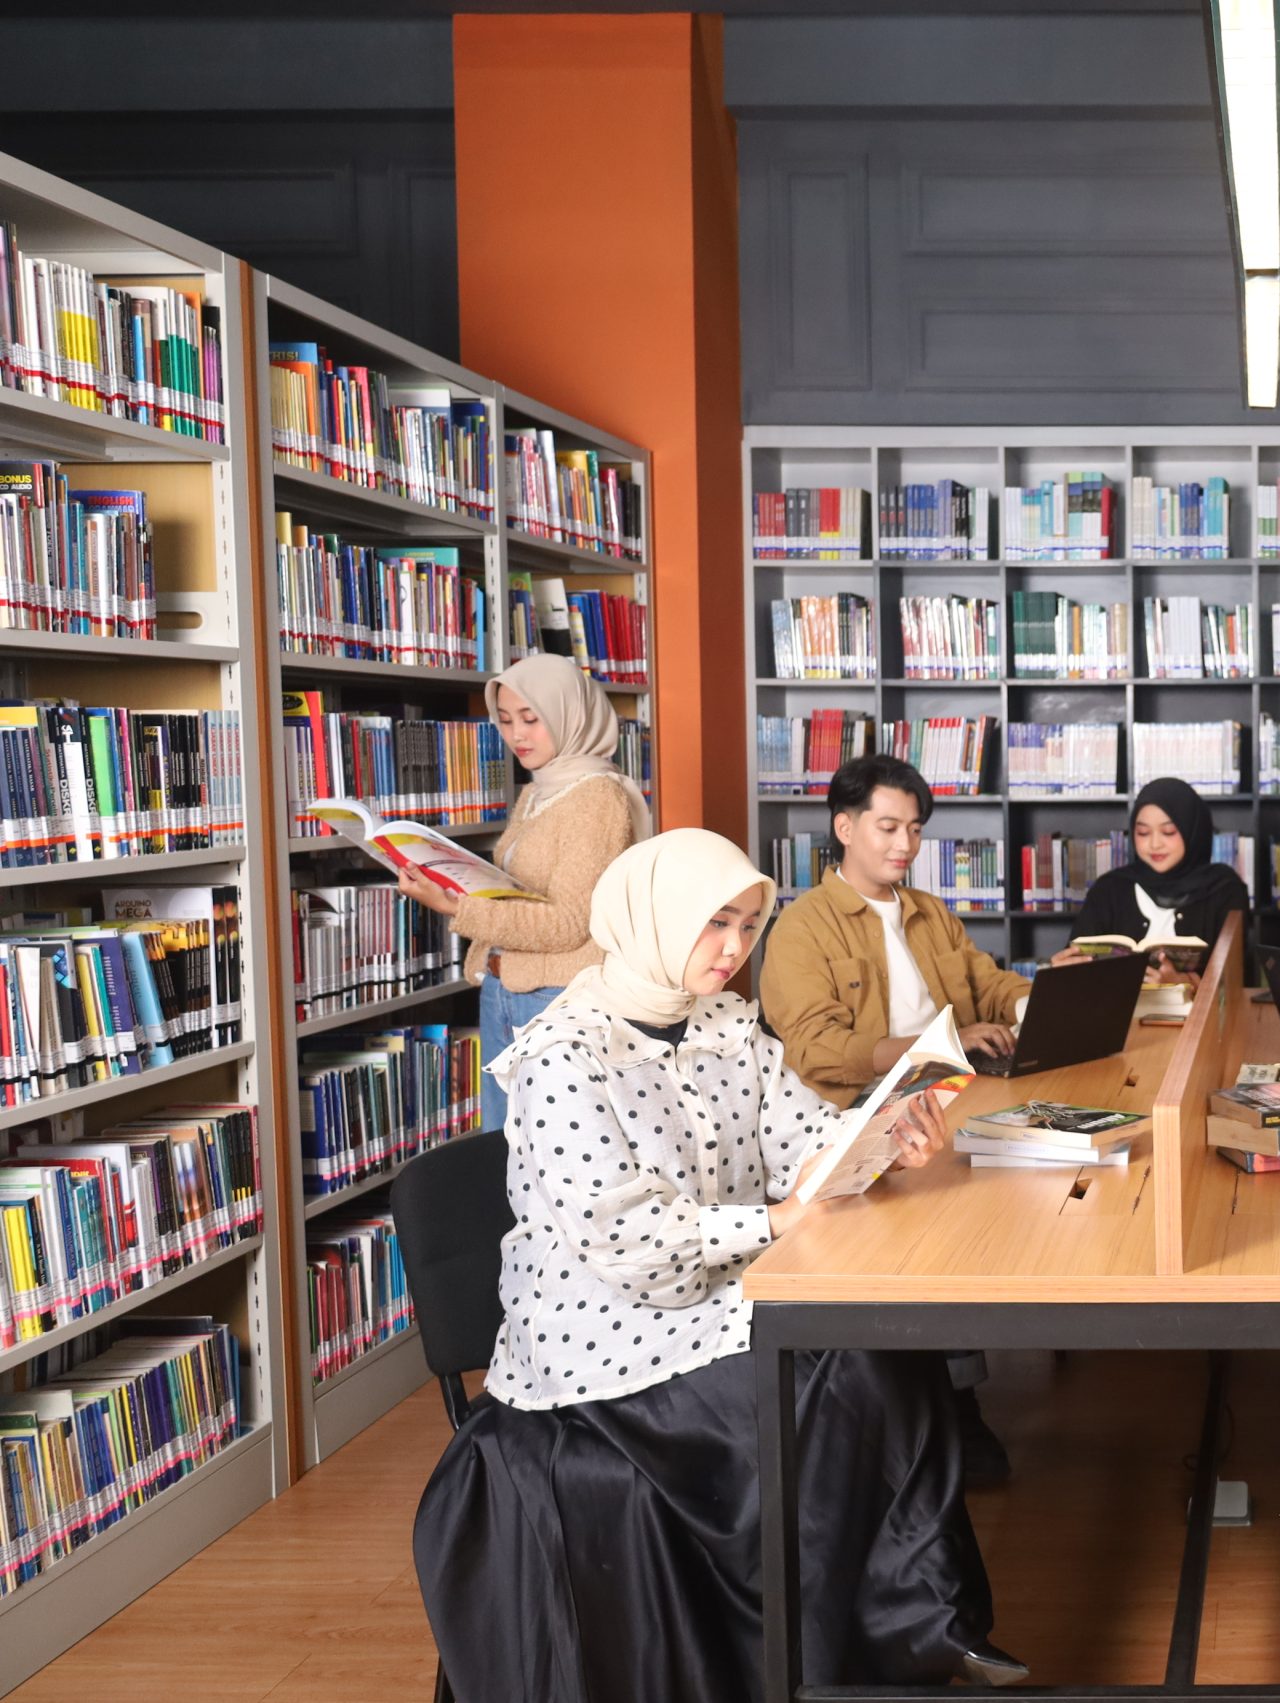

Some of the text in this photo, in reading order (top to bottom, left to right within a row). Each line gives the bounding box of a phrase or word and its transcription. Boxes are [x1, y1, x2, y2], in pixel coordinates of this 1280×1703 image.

[0, 474, 32, 484] BONUS
[87, 496, 134, 506] ENGLISH
[115, 899, 152, 908] ARDUINO
[115, 907, 152, 918] MEGA
